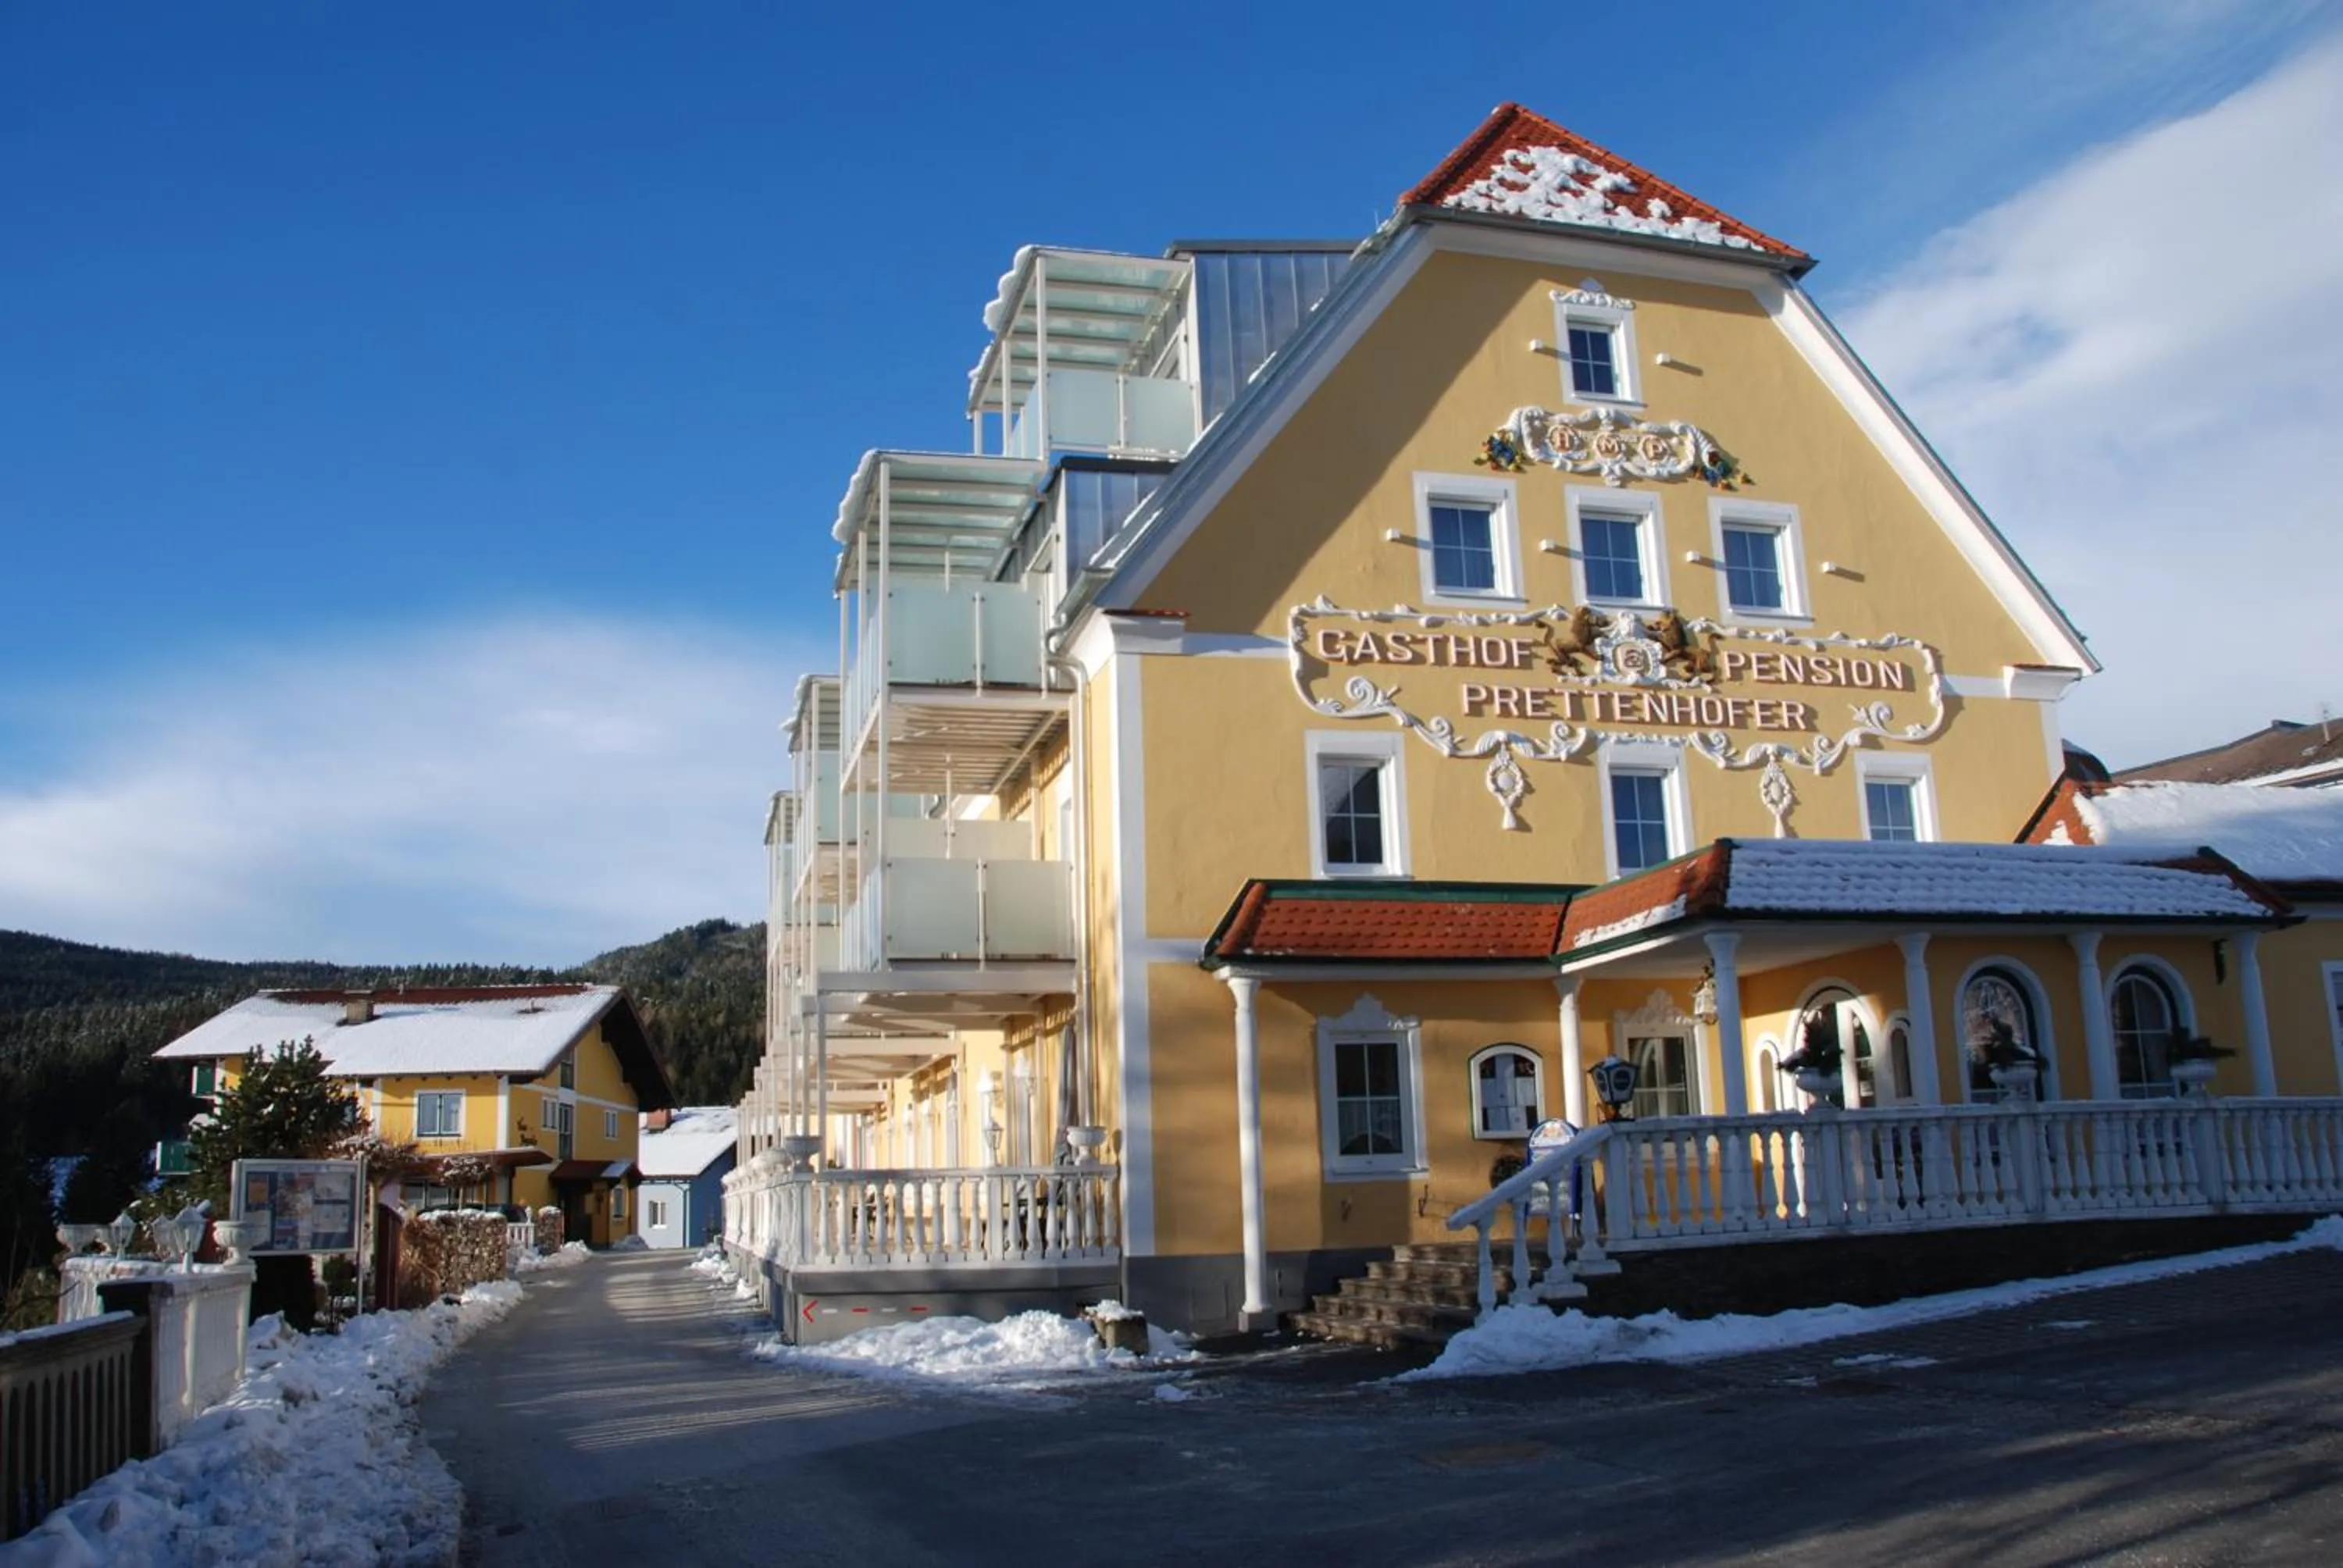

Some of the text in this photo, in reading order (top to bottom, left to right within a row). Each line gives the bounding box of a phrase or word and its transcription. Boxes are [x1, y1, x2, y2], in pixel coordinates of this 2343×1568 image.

[1317, 629, 1904, 690] GASTHOF PENSION
[1462, 682, 1807, 730] PRETTENHOFER
